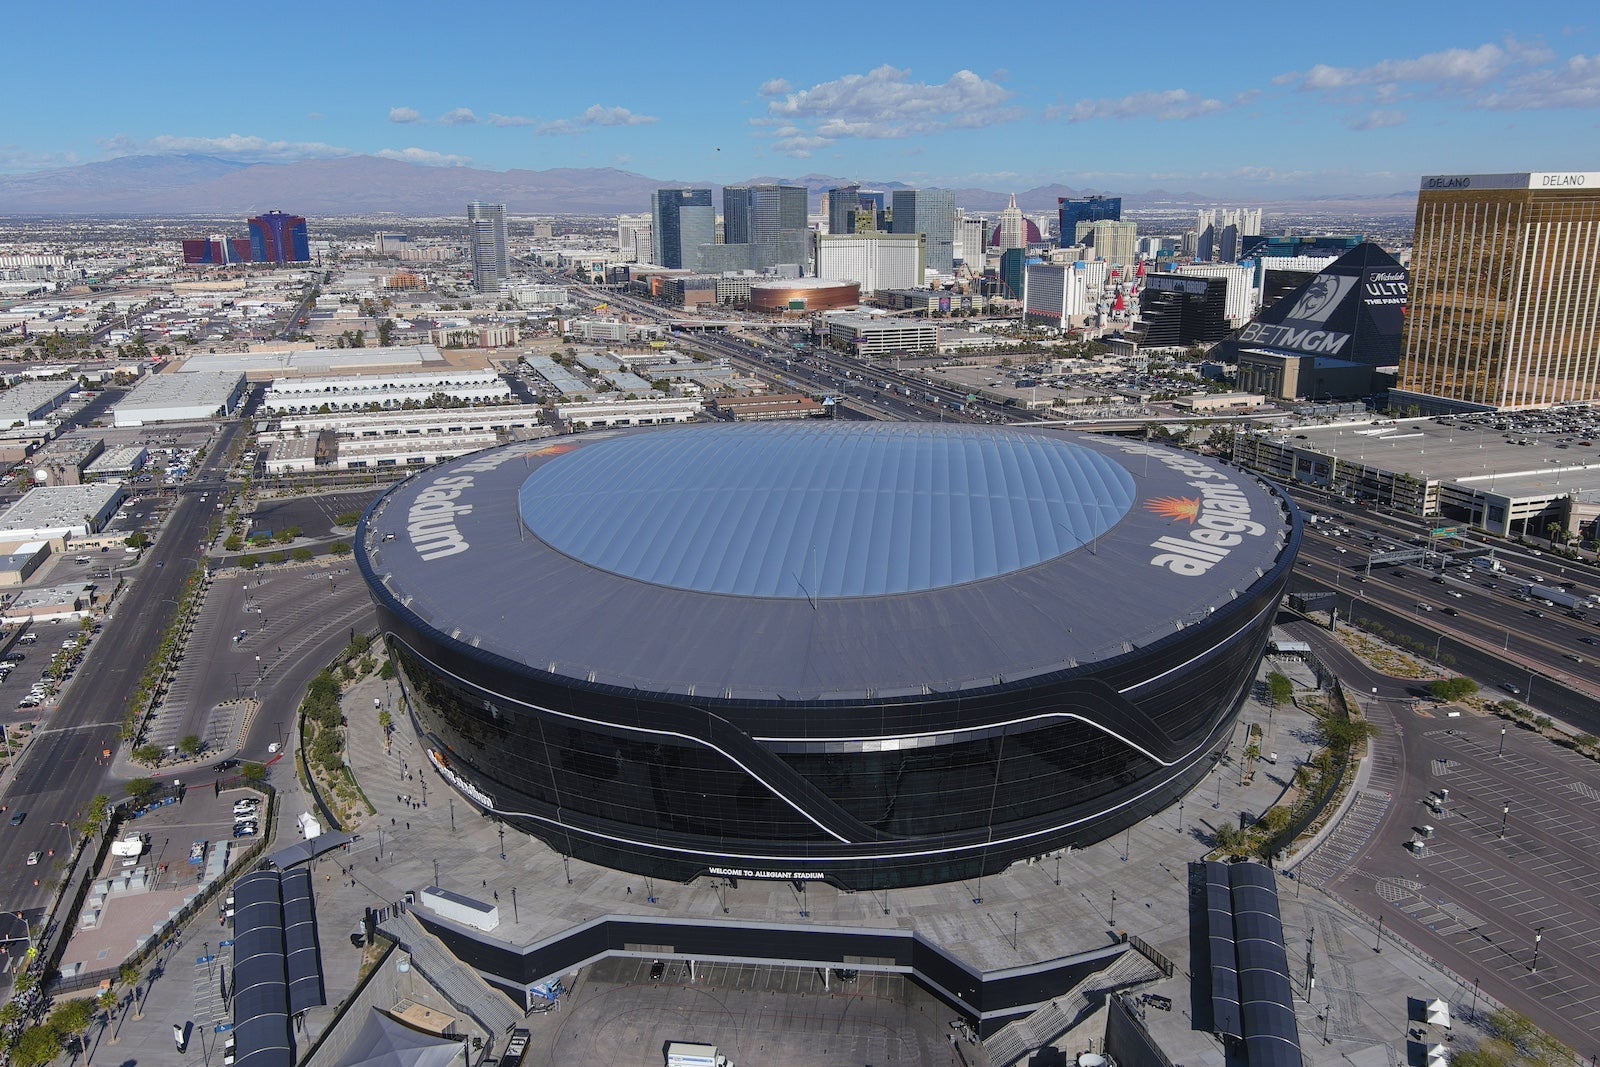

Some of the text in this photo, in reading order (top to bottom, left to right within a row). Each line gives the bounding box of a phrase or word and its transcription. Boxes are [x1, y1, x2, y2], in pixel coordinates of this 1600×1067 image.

[1429, 177, 1471, 188] DELANO
[1542, 175, 1585, 186] DELANO
[1370, 272, 1405, 282] Michelob
[1366, 282, 1408, 295] ULTR
[1239, 322, 1351, 354] BETMGM
[406, 476, 475, 561] stadium
[1150, 481, 1266, 576] allegiant
[709, 867, 742, 876] WELCOME
